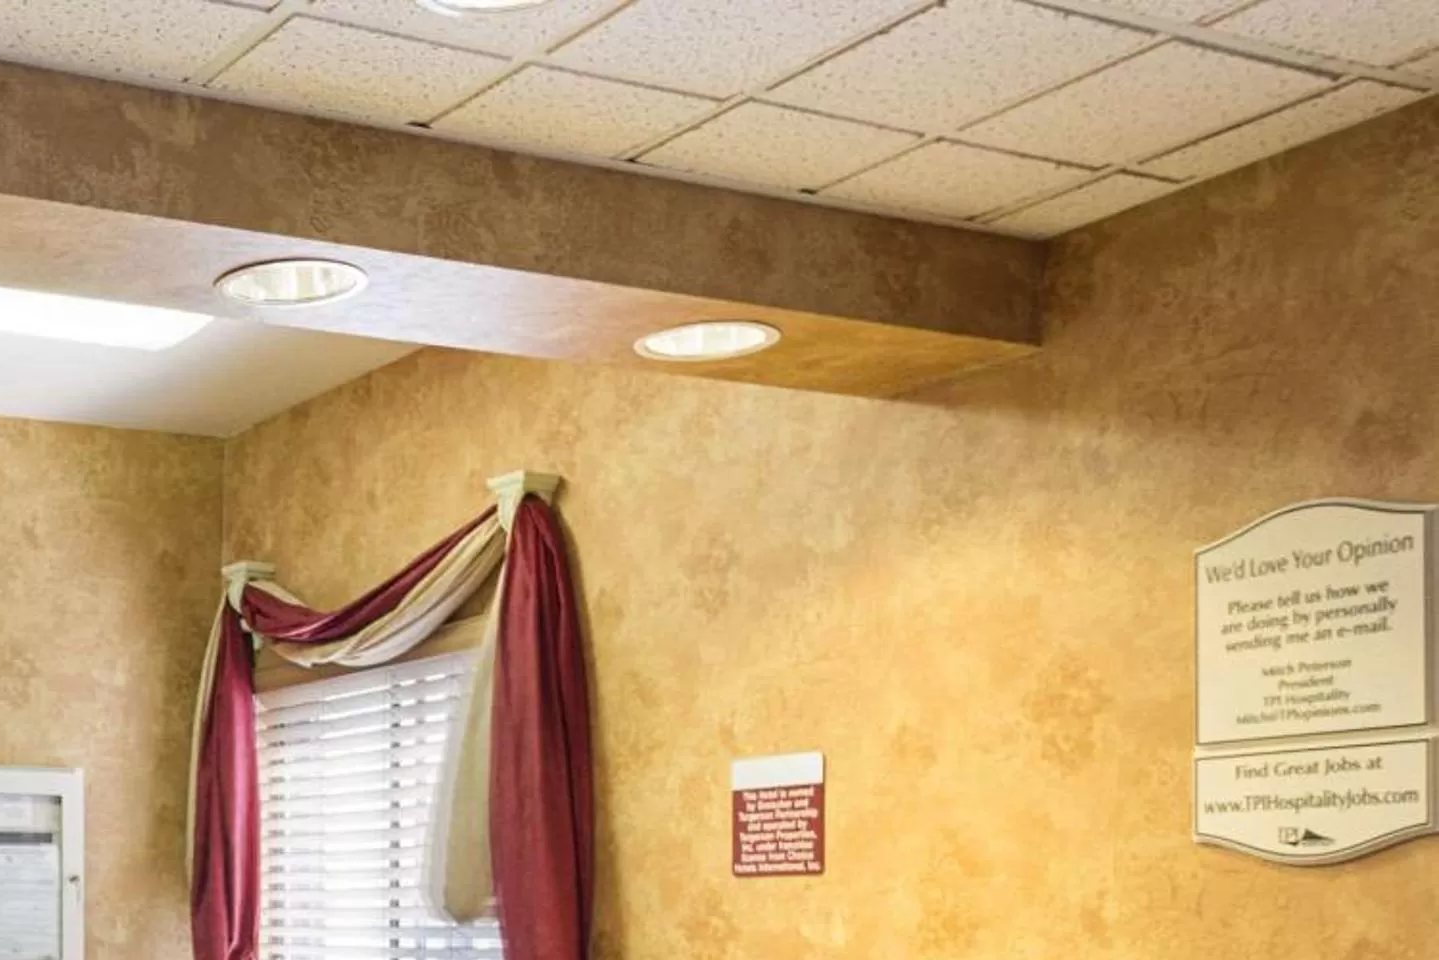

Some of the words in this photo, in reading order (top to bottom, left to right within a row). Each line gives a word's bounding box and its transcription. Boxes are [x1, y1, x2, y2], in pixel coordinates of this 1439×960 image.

[1205, 559, 1245, 584] We'd
[1249, 555, 1288, 579] Love
[1292, 549, 1332, 570] Your
[1337, 534, 1415, 567] Opinion
[1221, 622, 1243, 635] are
[1247, 613, 1288, 633] doing
[1292, 610, 1309, 625] by
[1315, 596, 1398, 623] personally
[1227, 597, 1273, 616] Please
[1277, 590, 1301, 608] tell
[1304, 591, 1322, 604] us
[1325, 584, 1359, 600] how
[1364, 580, 1389, 593] we
[1225, 633, 1282, 653] sending
[1286, 631, 1309, 645] me
[1313, 626, 1332, 641] an
[1235, 763, 1268, 780] Find
[1273, 761, 1319, 777] Great
[1324, 756, 1361, 775] Jobs
[1366, 756, 1383, 770] at
